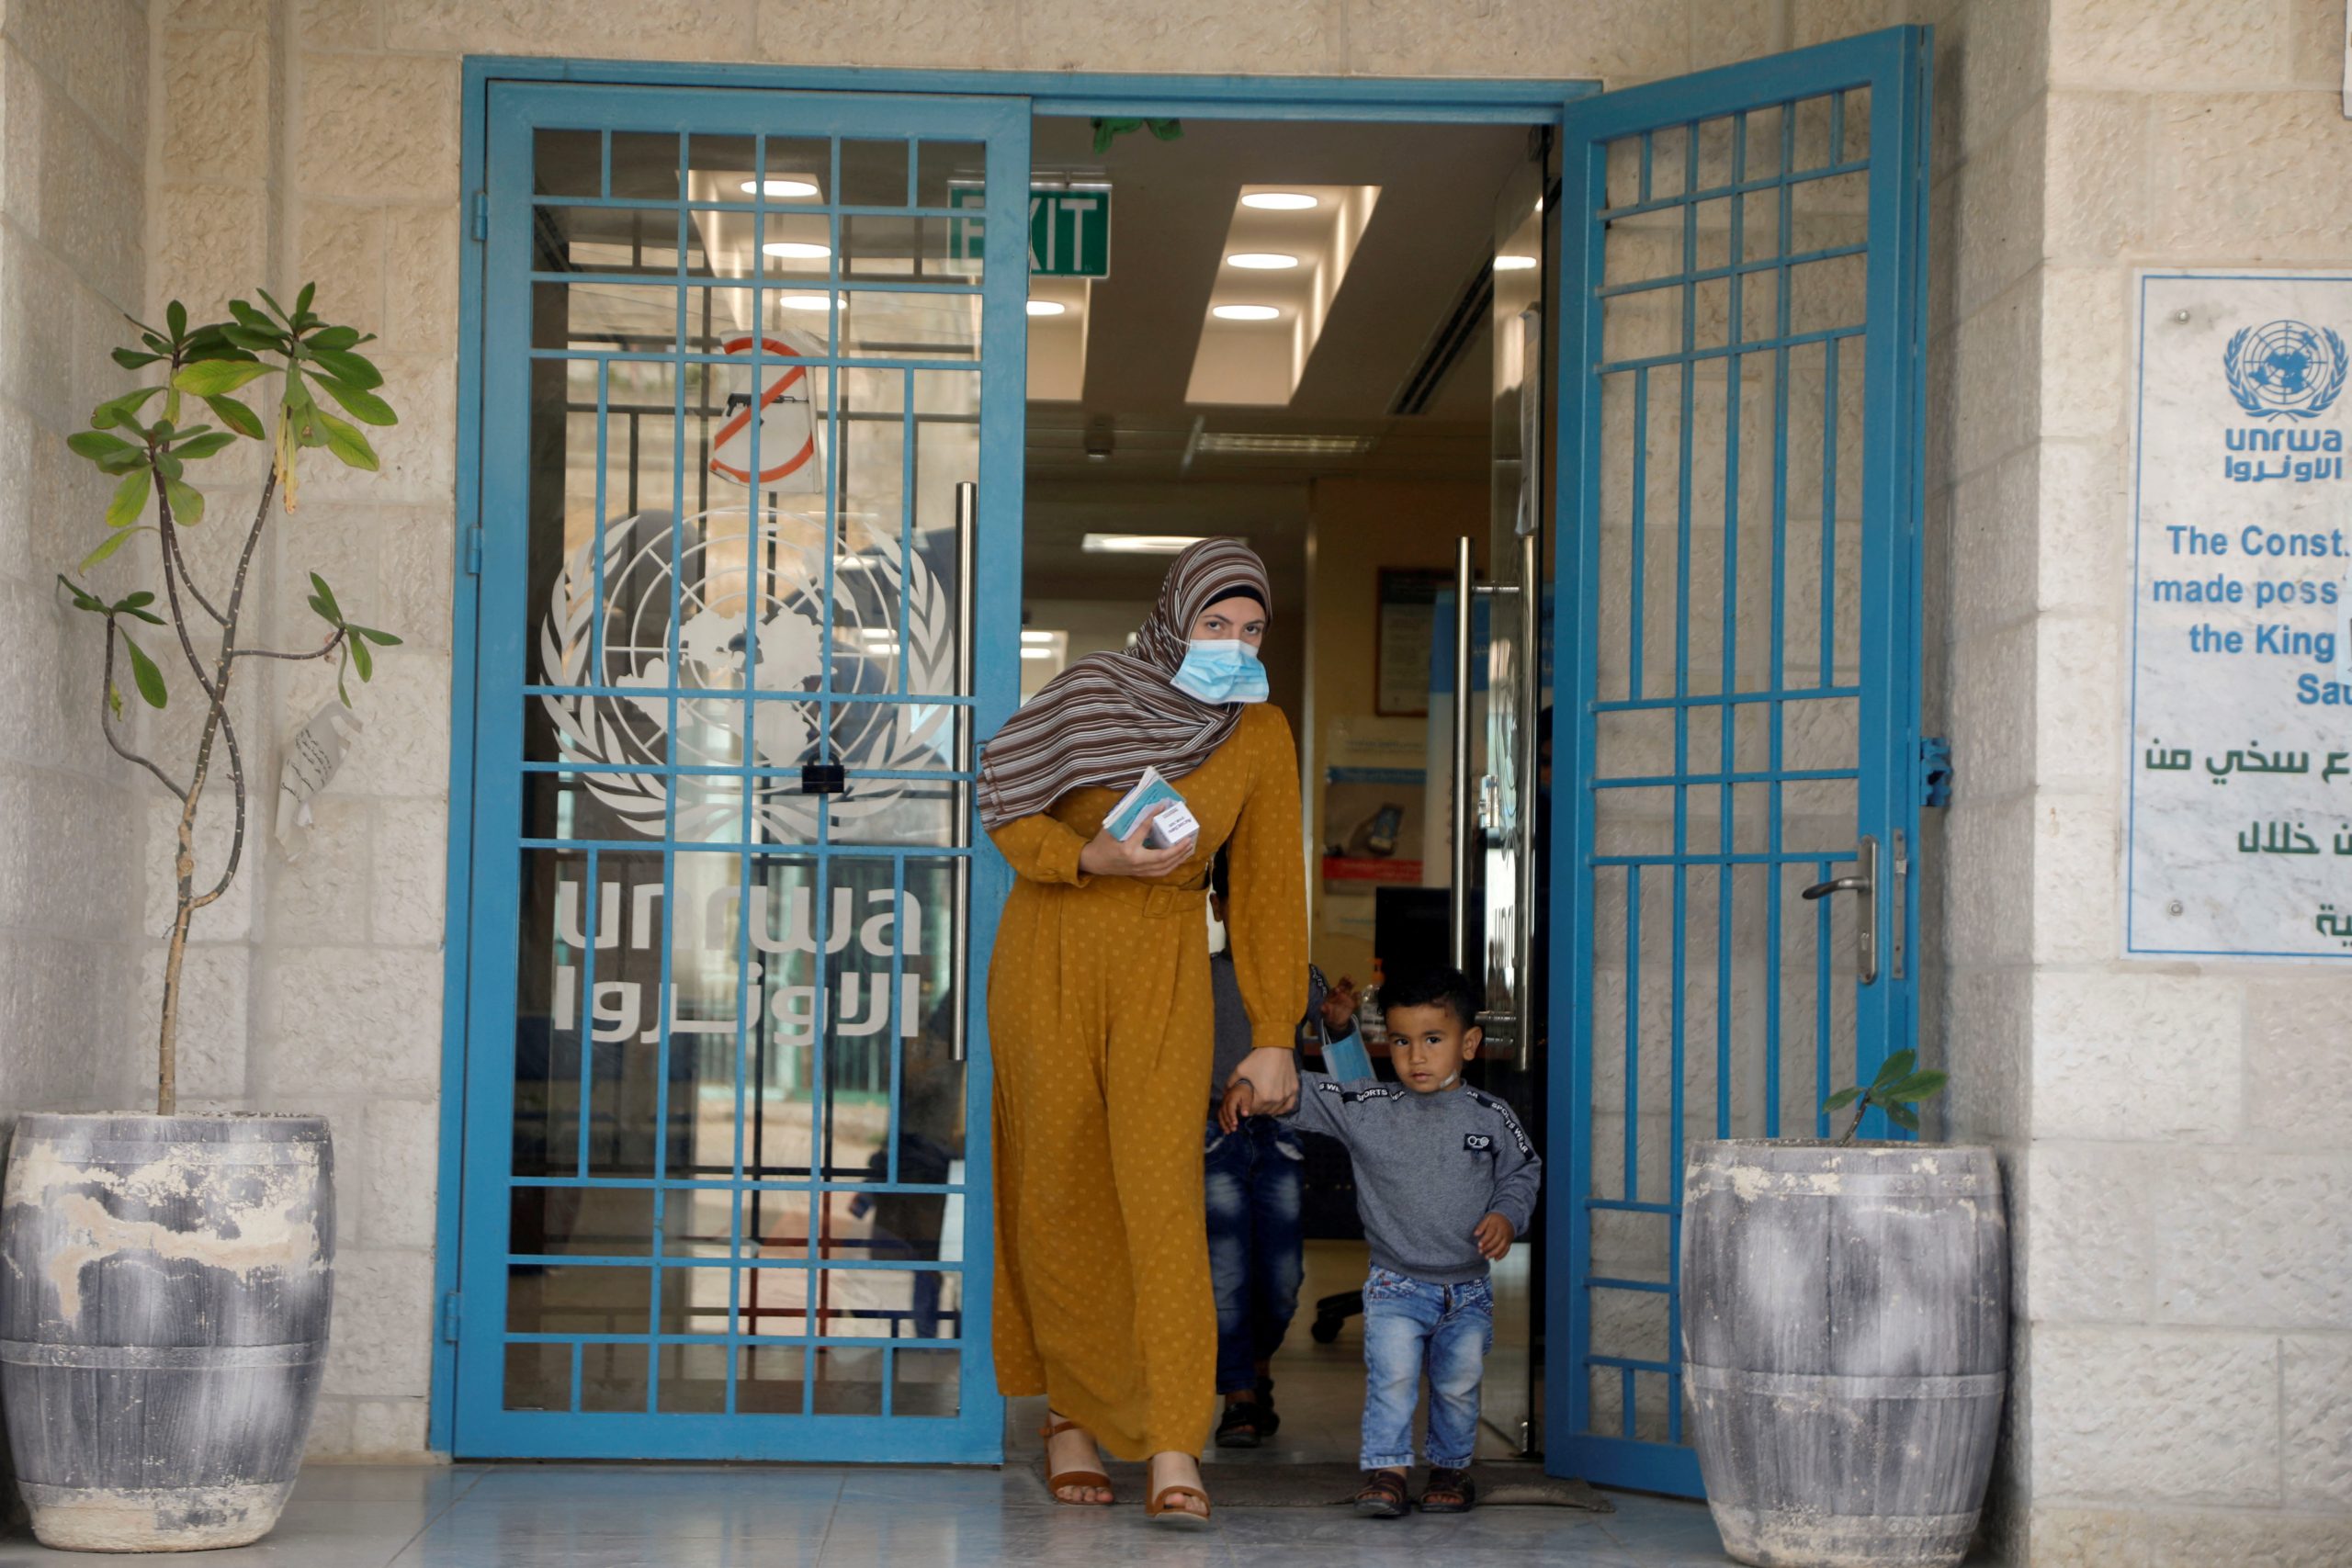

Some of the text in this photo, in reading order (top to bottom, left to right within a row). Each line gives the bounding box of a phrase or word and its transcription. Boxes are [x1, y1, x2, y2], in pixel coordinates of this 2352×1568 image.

[2225, 427, 2343, 453] unrwa
[2166, 525, 2350, 558] The Const
[2153, 573, 2339, 610] made poss
[2189, 624, 2244, 654] the
[2145, 738, 2191, 771] من
[2205, 740, 2309, 784] سخي
[2238, 821, 2321, 855] خلال
[558, 880, 922, 957] unrwa
